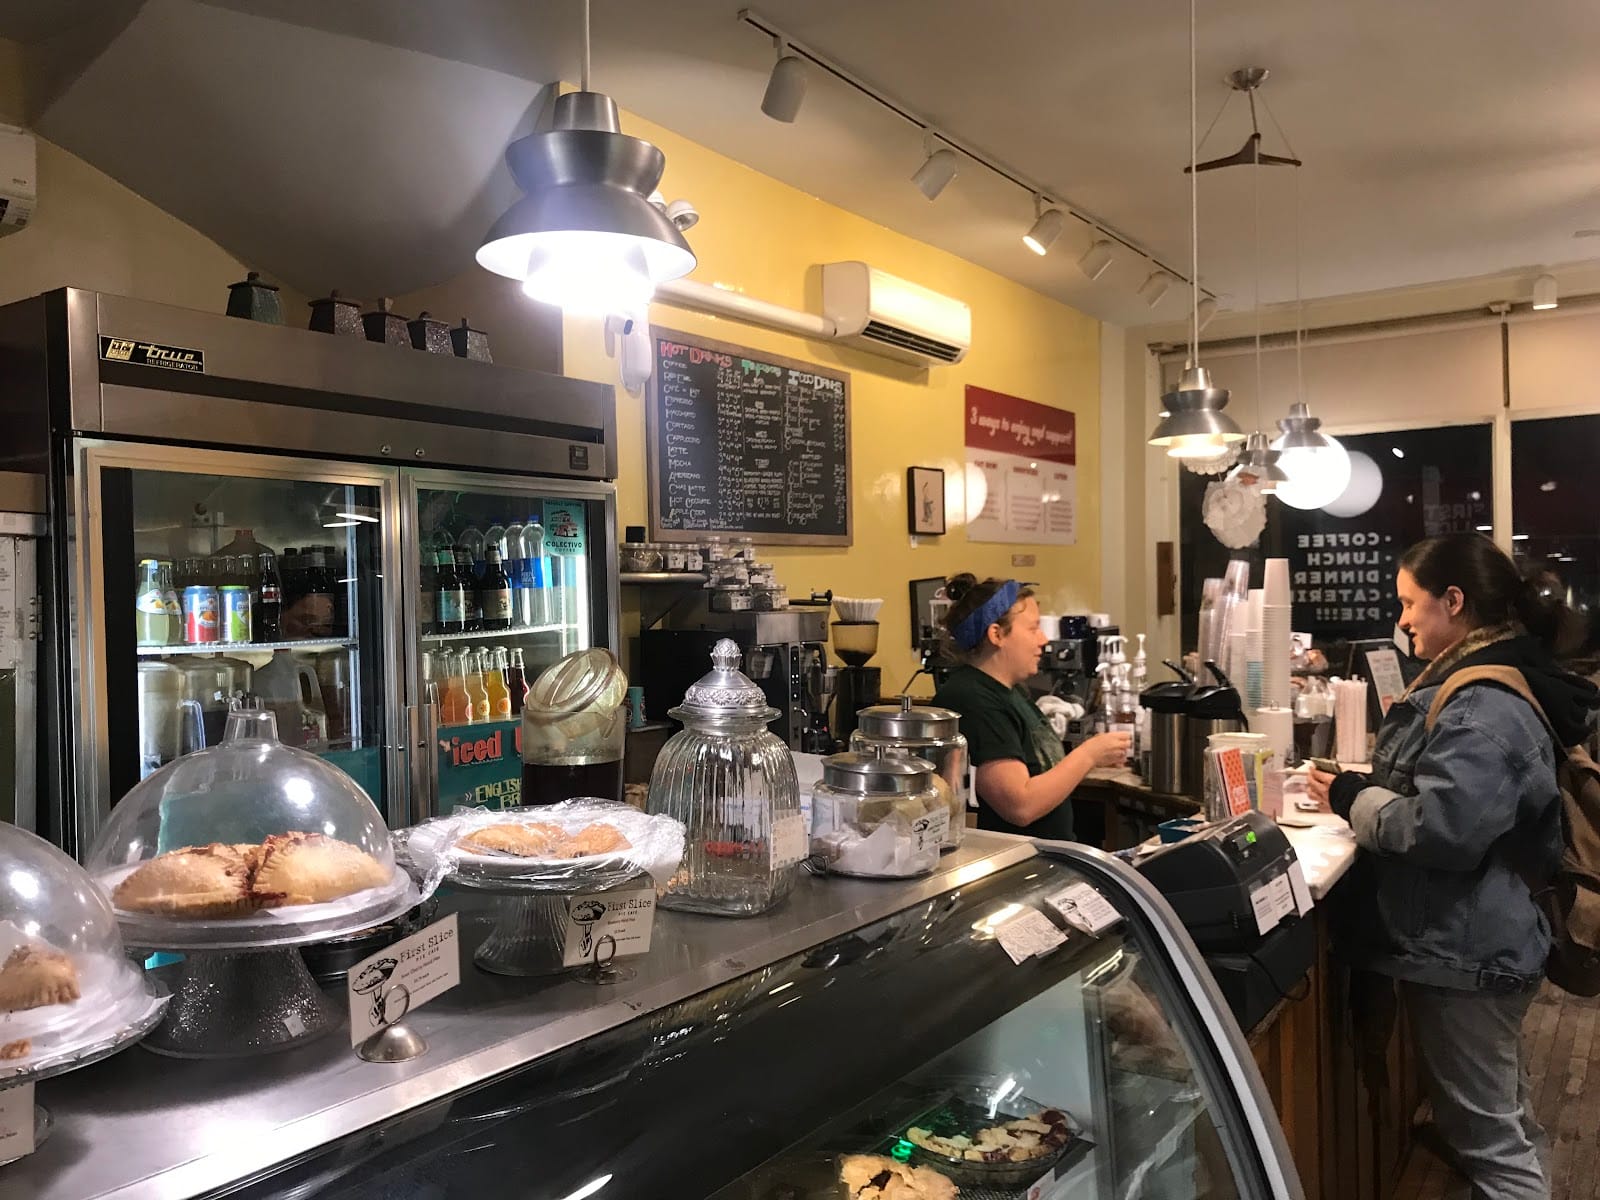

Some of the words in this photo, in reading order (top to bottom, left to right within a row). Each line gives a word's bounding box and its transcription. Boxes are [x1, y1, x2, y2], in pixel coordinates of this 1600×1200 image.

[139, 344, 203, 365] true
[661, 341, 689, 358] HOT
[690, 347, 733, 368] DRINKS
[970, 406, 978, 425] 3
[979, 416, 1000, 437] ways
[667, 446, 688, 457] LATTE
[668, 459, 691, 469] MOCHA
[669, 496, 683, 507] HOT
[546, 541, 582, 550] COLECTIVO
[452, 730, 502, 765] iced
[607, 901, 627, 912] First
[628, 898, 651, 910] Slice
[399, 943, 426, 963] First
[428, 929, 454, 948] Slice
